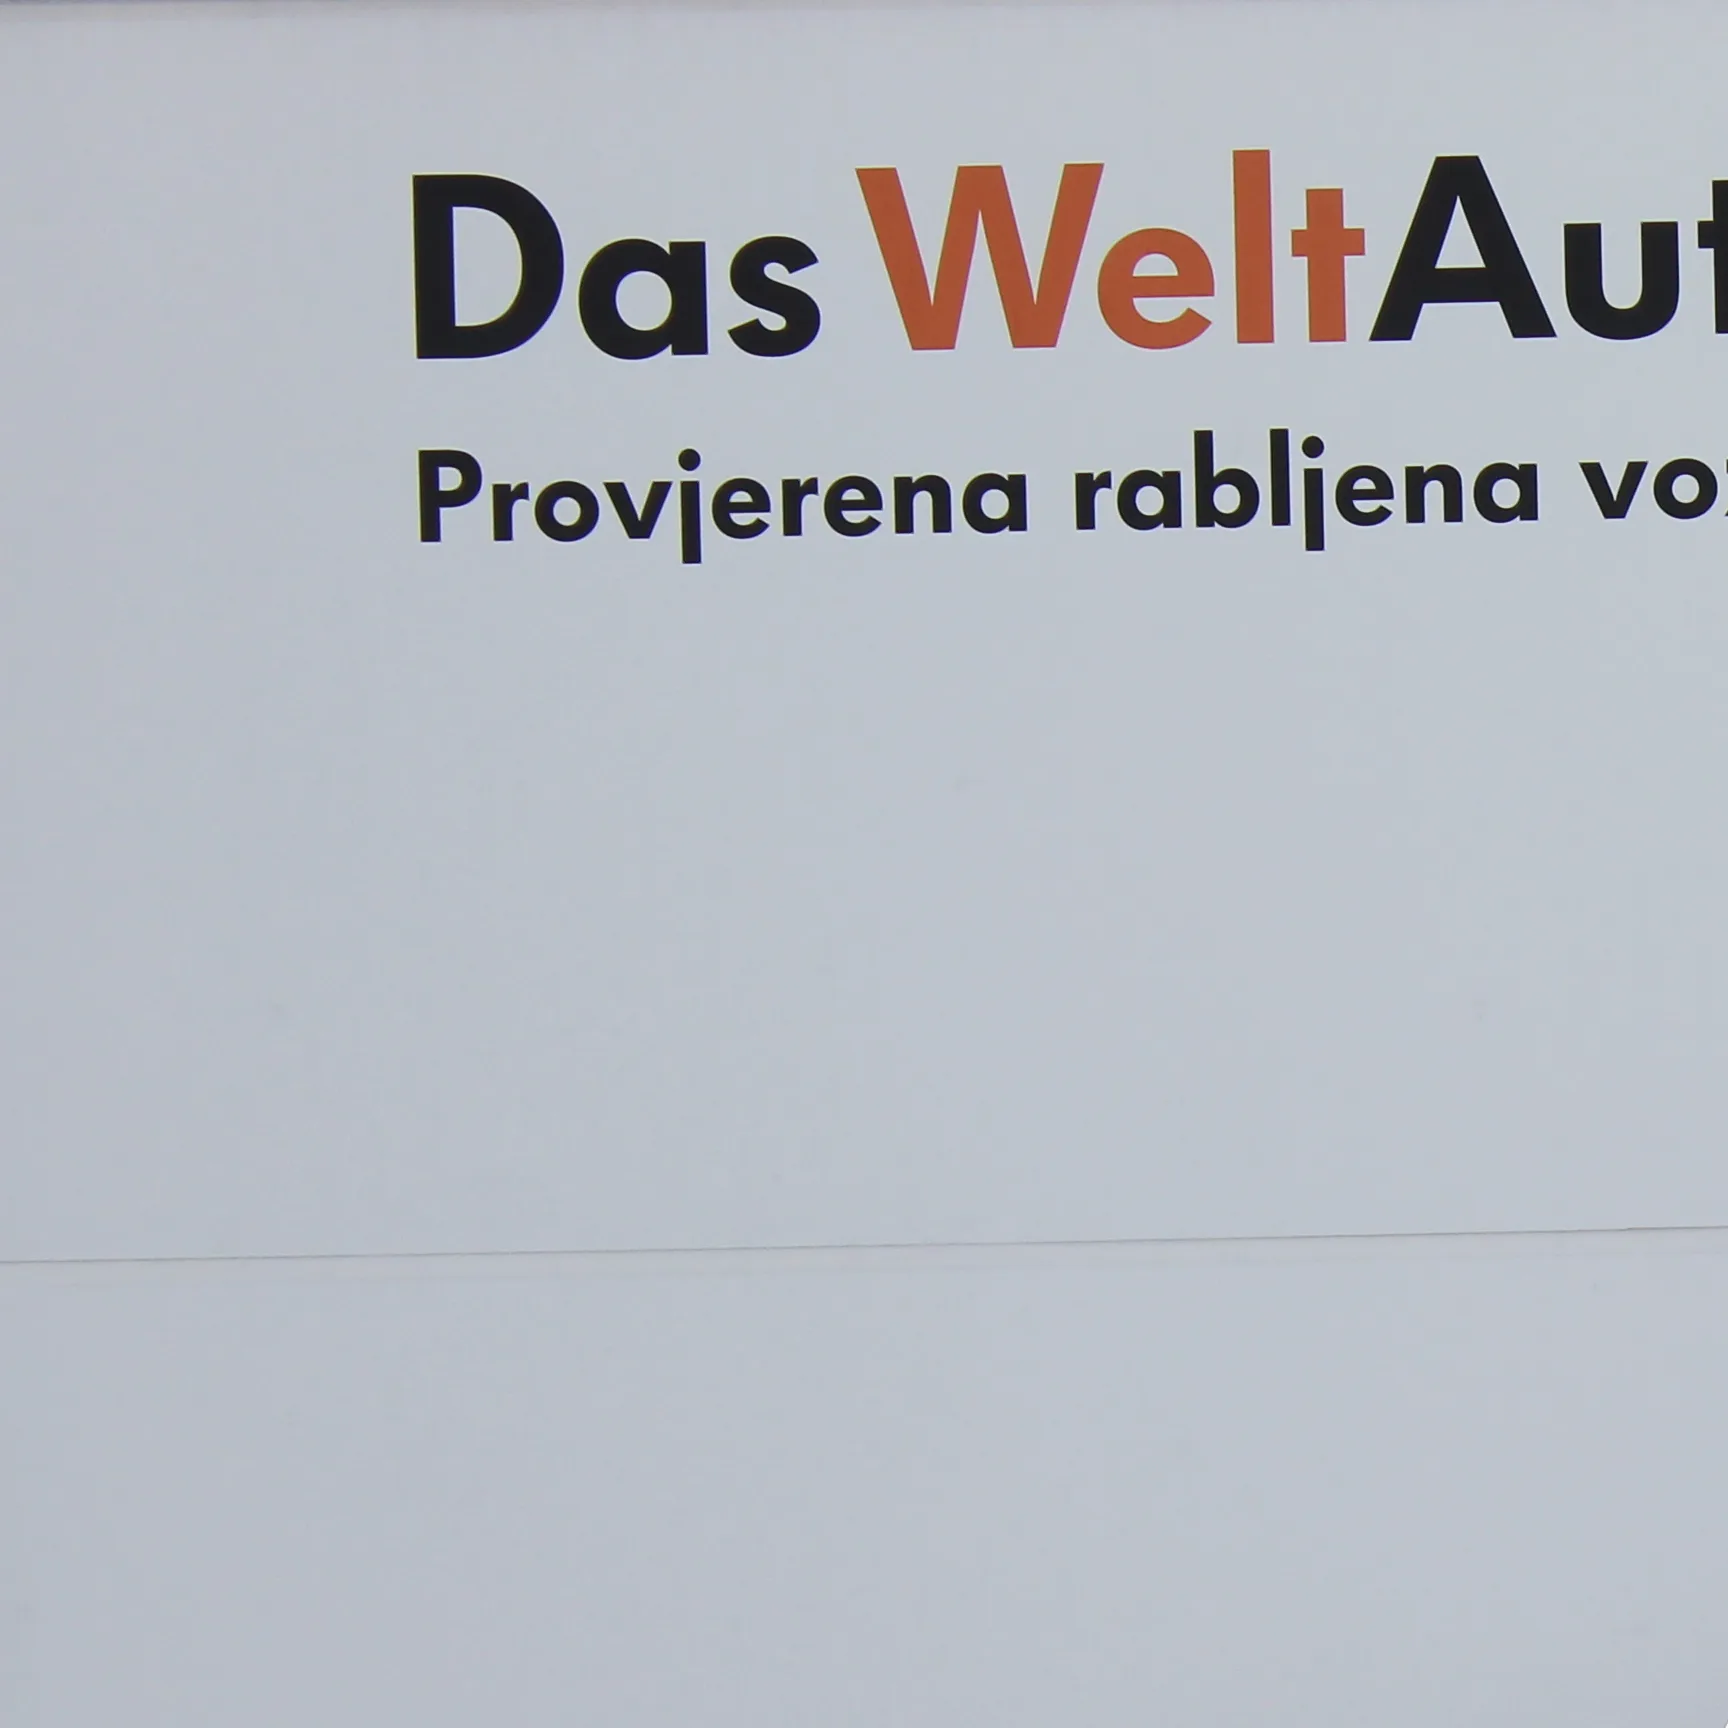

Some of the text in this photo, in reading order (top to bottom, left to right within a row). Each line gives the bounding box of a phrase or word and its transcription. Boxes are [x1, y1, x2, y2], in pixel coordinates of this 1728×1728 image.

[411, 173, 821, 360] Das
[417, 448, 1028, 565] Provjerena
[1074, 429, 1539, 552] rabljena
